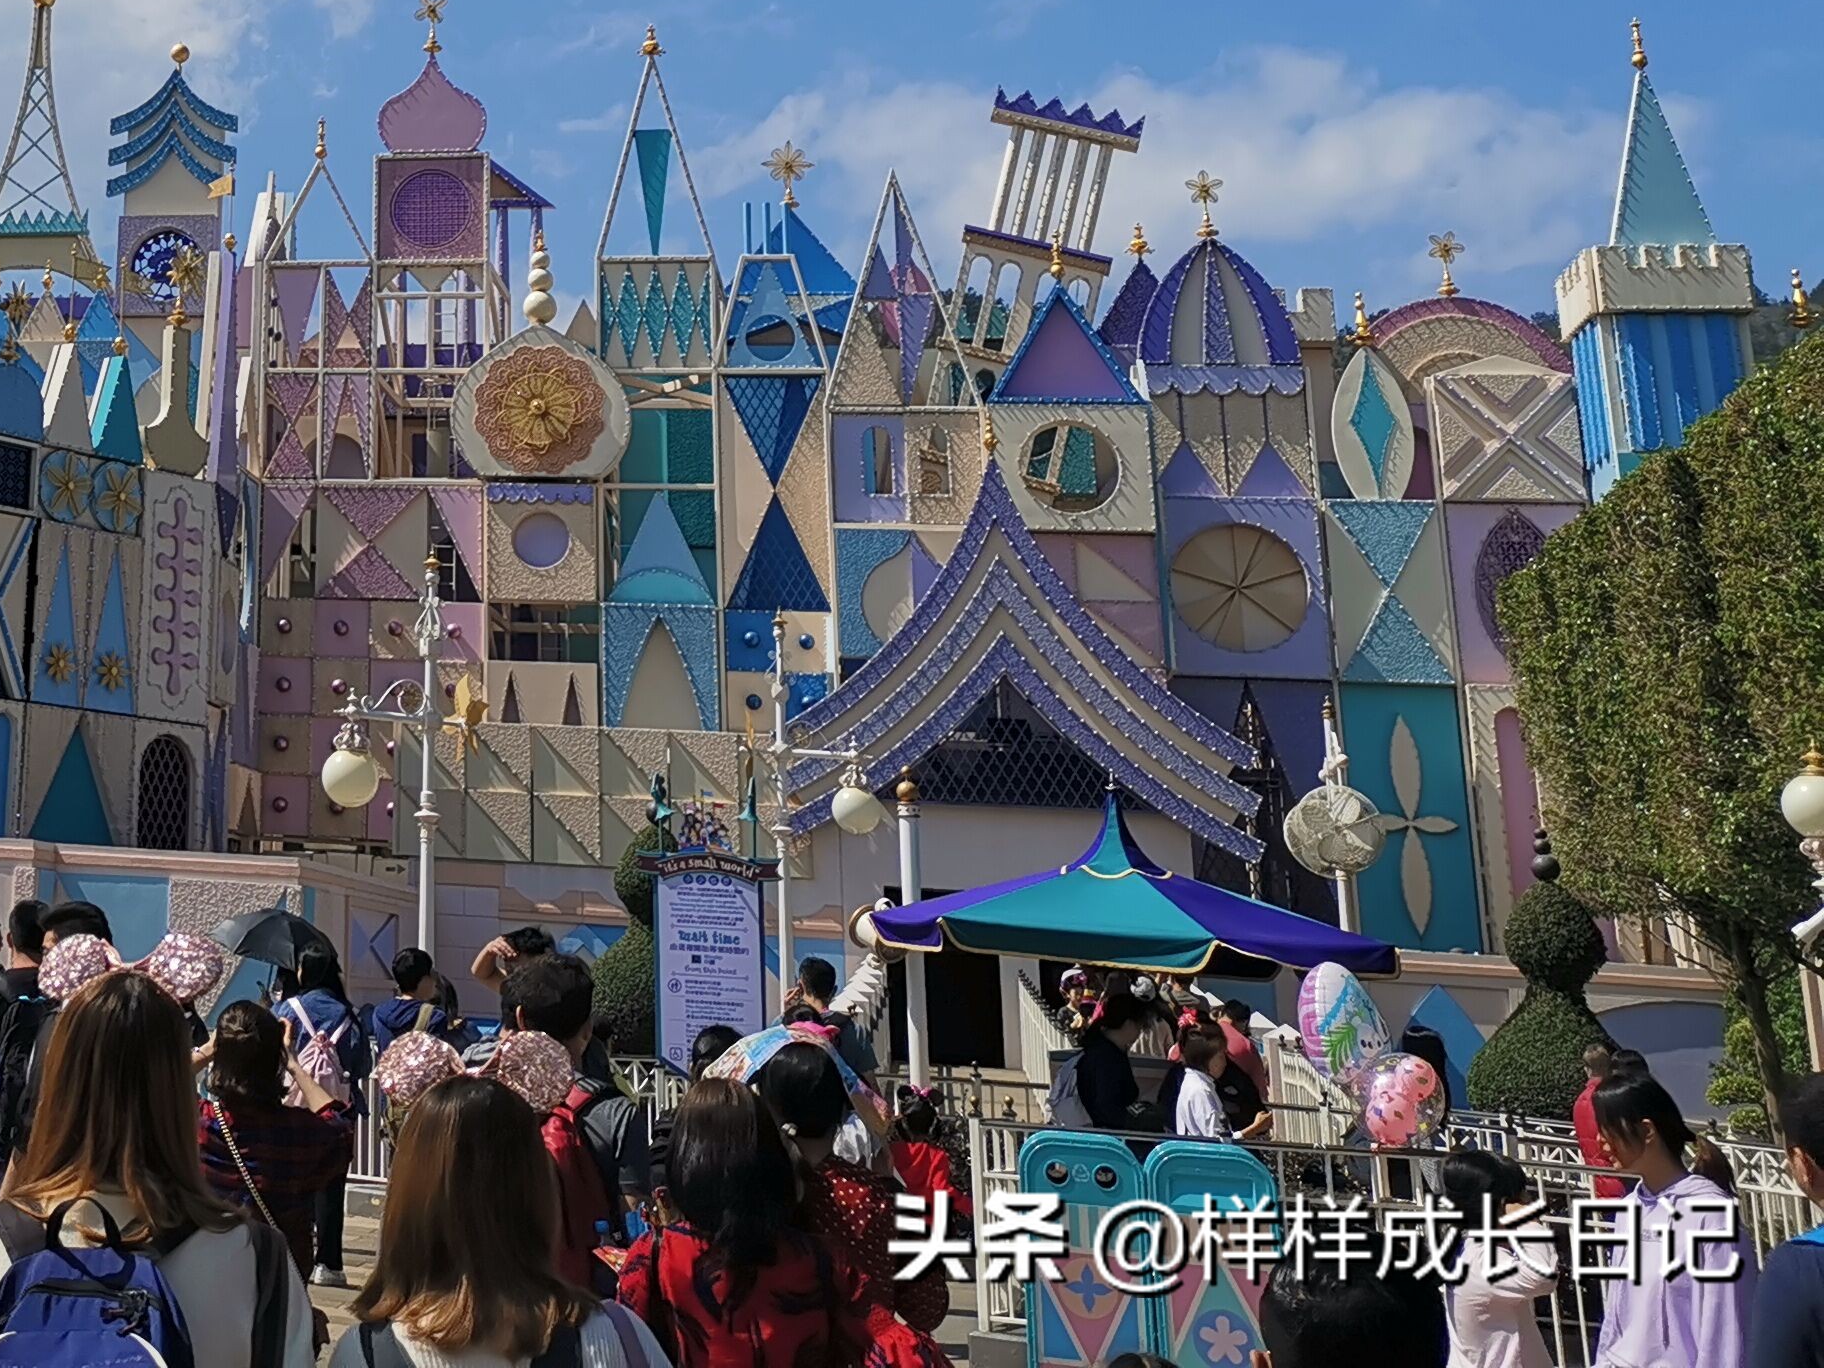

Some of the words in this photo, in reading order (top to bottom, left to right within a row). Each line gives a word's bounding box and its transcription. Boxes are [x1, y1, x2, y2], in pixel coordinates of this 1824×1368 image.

[688, 856, 717, 870] small
[678, 930, 708, 943] wait
[712, 931, 740, 945] time
